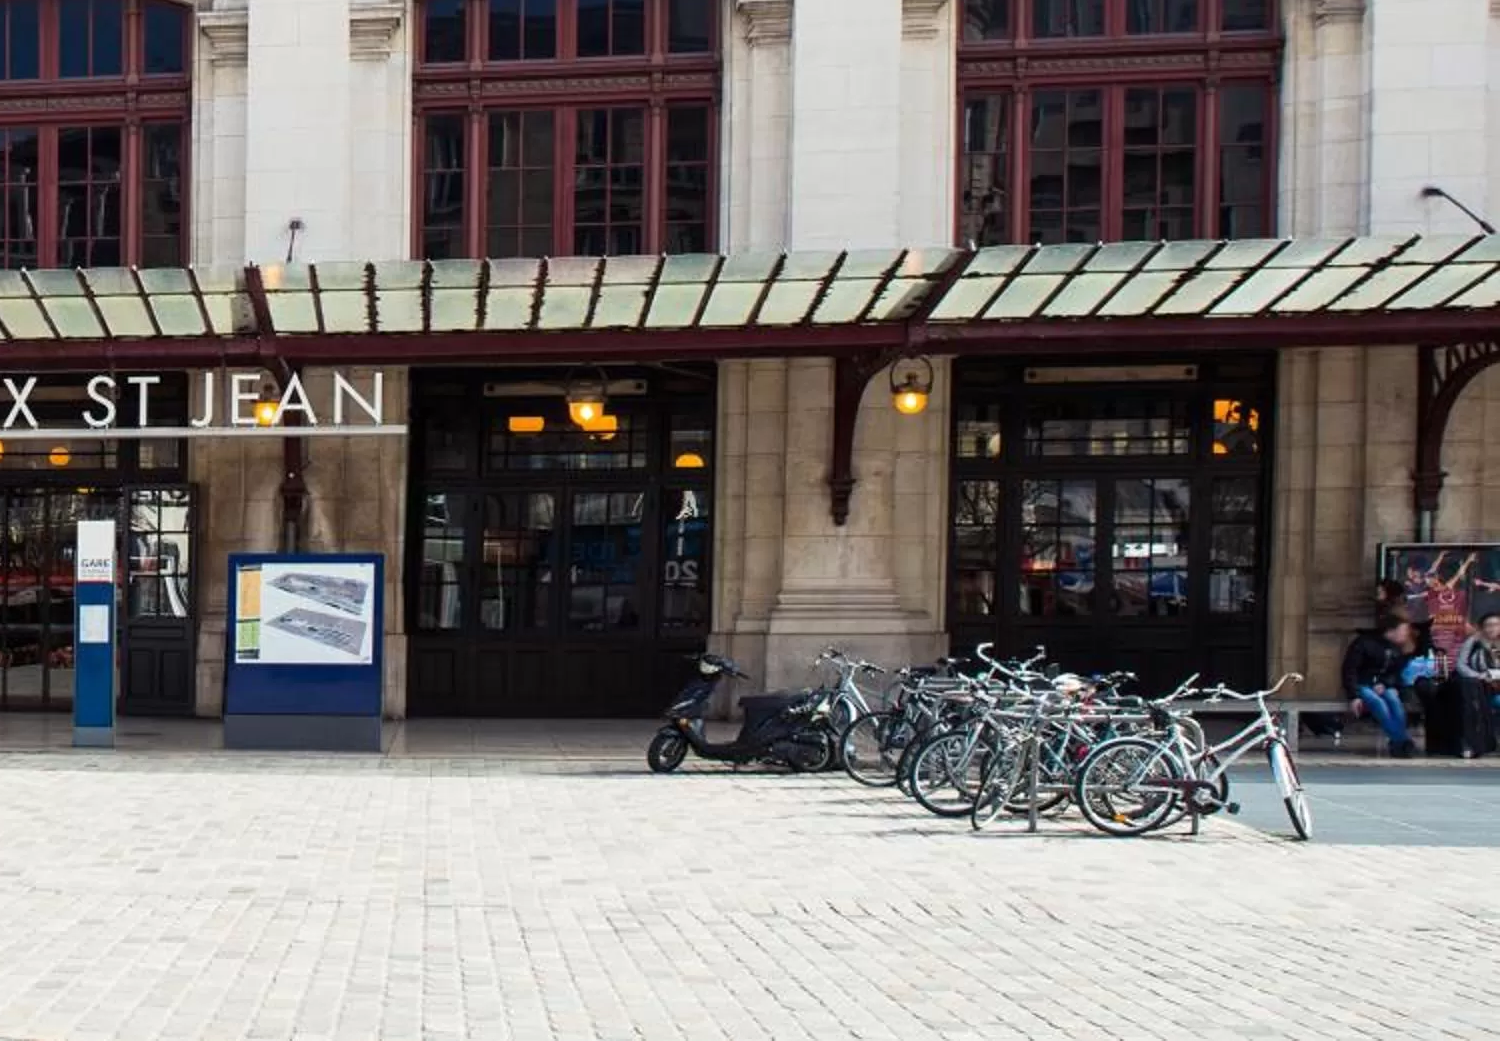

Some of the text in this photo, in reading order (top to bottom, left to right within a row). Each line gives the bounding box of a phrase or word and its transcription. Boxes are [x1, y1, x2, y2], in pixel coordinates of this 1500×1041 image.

[82, 375, 161, 428] ST
[191, 371, 384, 428] JEAN
[80, 558, 111, 568] GARE
